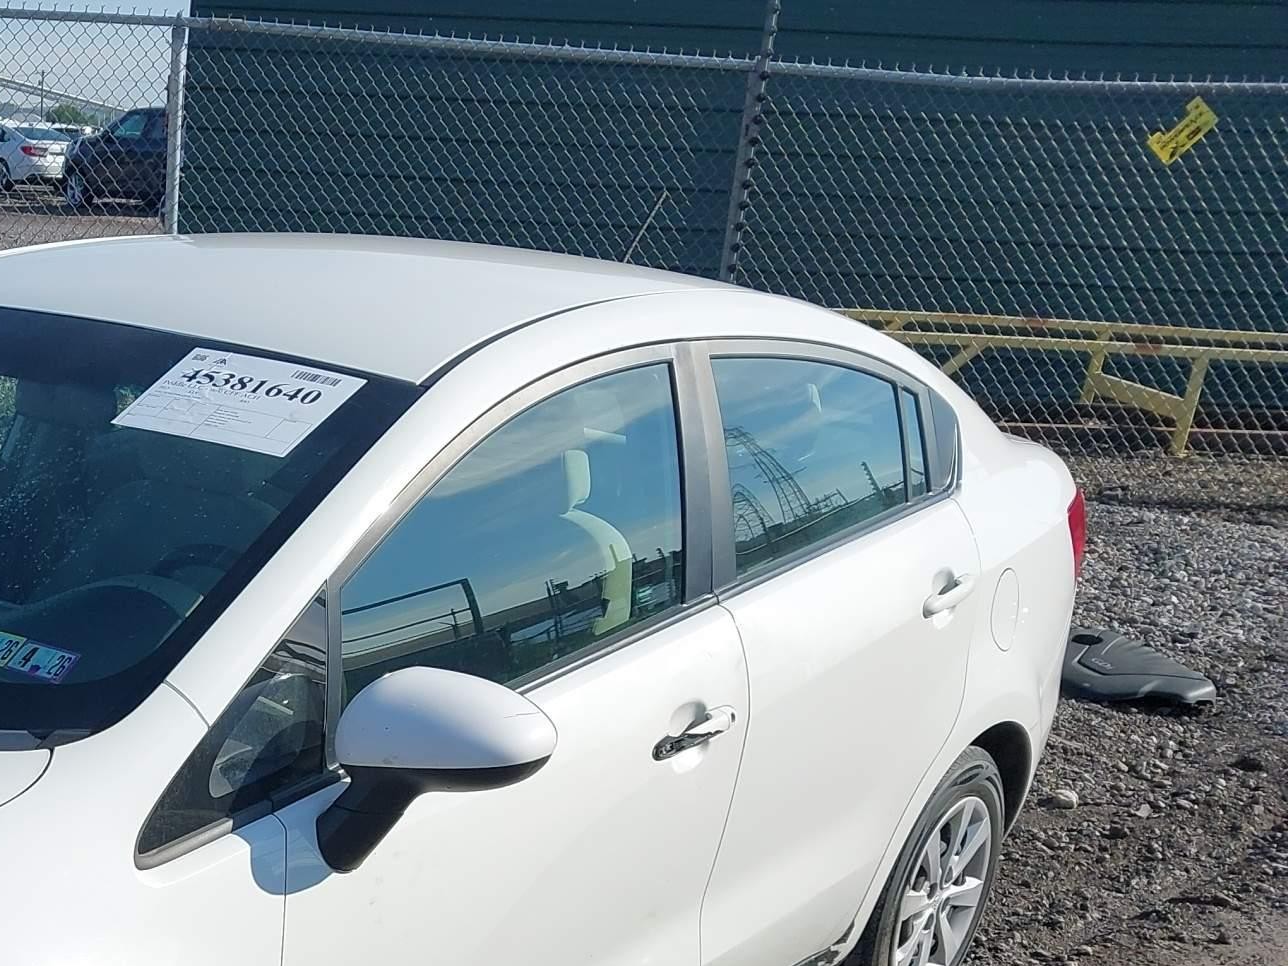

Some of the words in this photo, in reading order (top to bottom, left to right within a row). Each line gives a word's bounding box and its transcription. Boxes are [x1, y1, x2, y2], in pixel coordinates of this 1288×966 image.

[181, 367, 322, 405] 45381640
[18, 647, 40, 668] 4
[47, 655, 73, 677] 26
